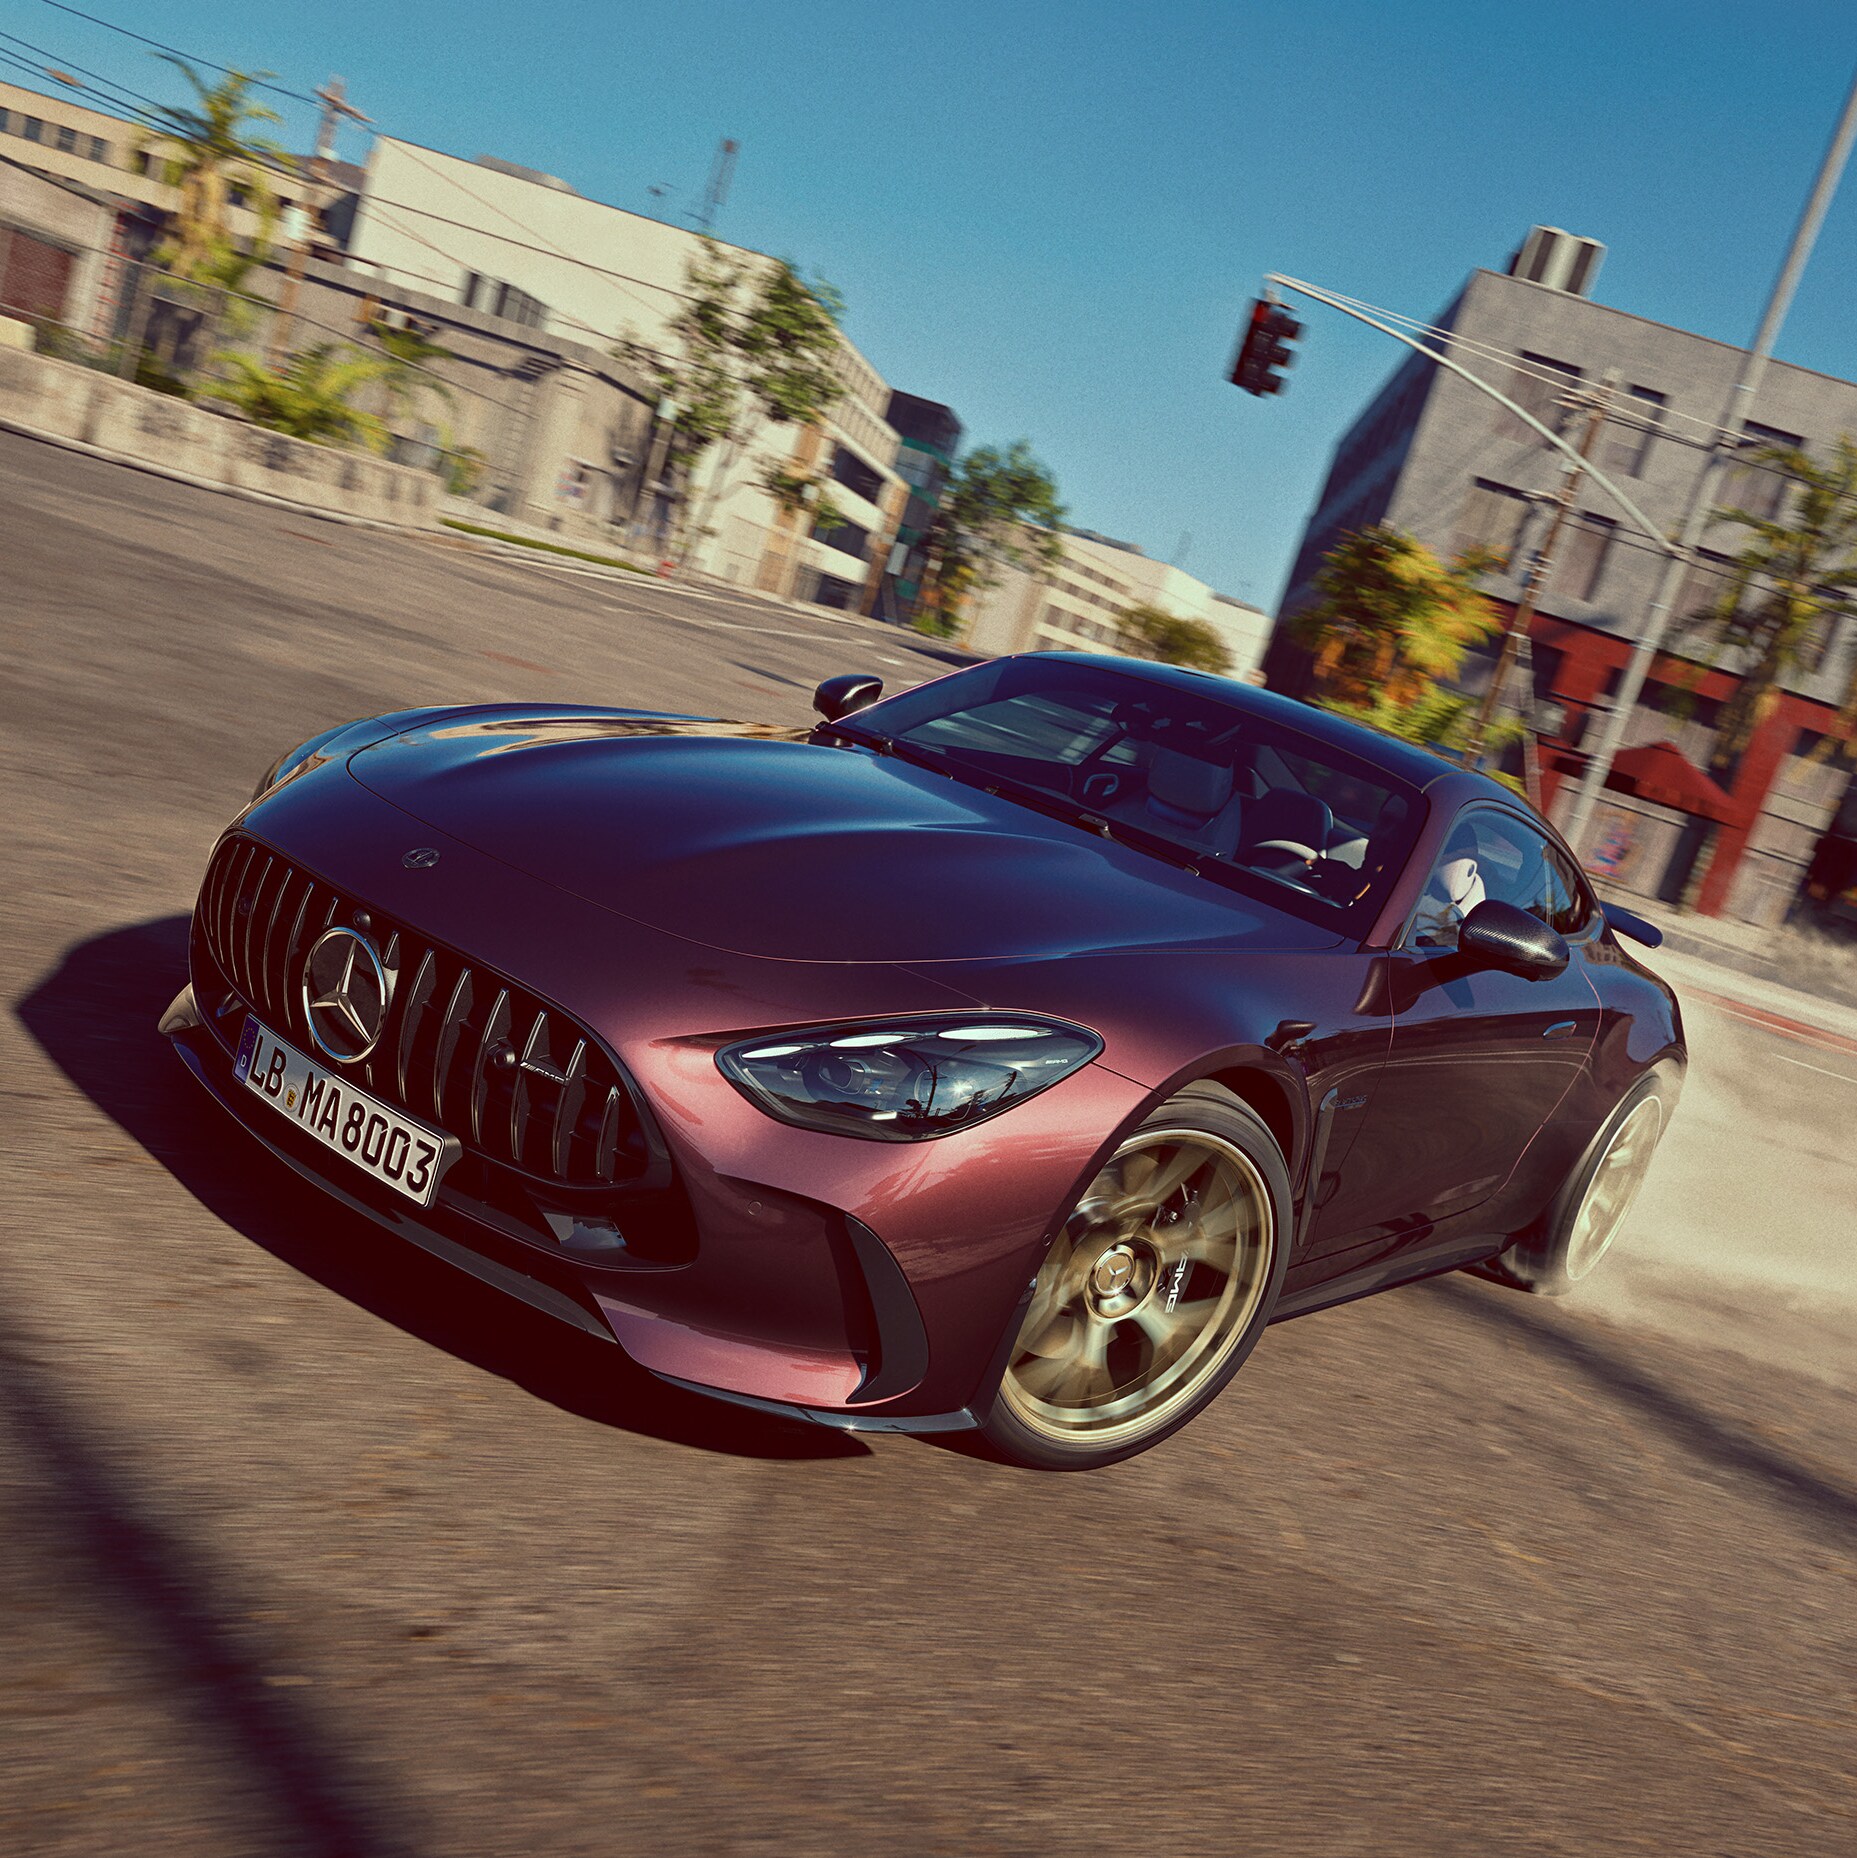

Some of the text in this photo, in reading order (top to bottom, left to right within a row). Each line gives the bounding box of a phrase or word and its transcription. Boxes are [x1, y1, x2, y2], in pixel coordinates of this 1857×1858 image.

[240, 1054, 247, 1068] D
[250, 1034, 287, 1098] LB
[1164, 1251, 1188, 1313] AMG
